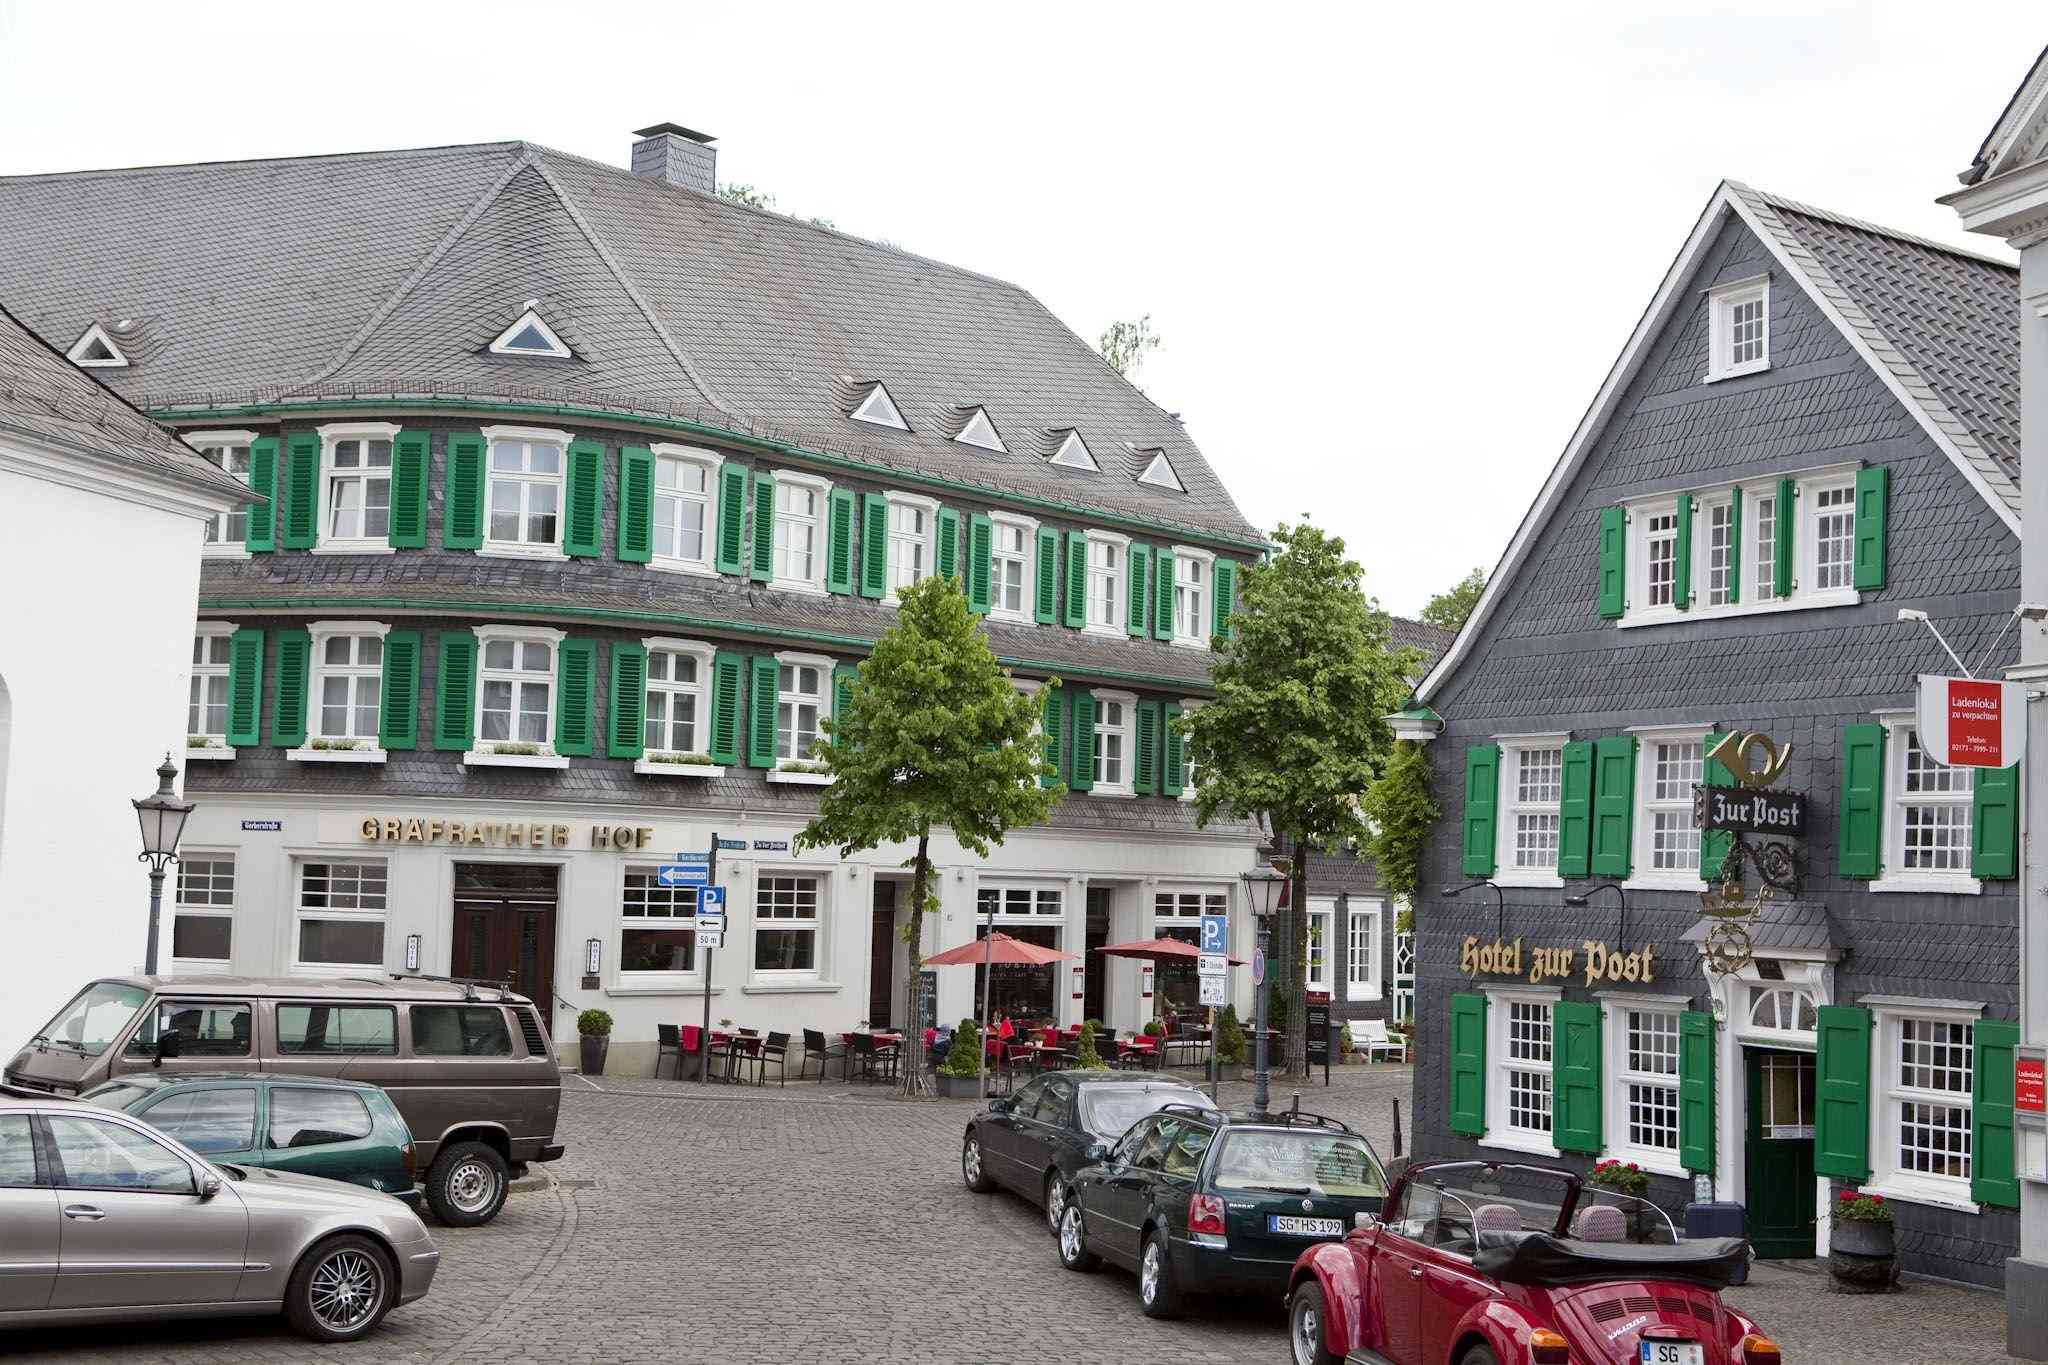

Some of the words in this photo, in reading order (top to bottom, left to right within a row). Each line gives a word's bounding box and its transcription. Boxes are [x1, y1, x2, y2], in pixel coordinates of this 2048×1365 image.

[1952, 696, 1997, 709] Ladenlokal
[1952, 711, 1961, 719] zu
[1962, 711, 1998, 721] verpachten
[1753, 796, 1799, 828] Post
[361, 816, 571, 848] GRÄFRATHER
[591, 823, 656, 849] HOF
[700, 936, 709, 944] 50
[1205, 920, 1219, 949] P
[1459, 935, 1524, 980] Hotel
[1529, 946, 1573, 984] zur
[1583, 939, 1656, 988] Post
[1279, 1218, 1294, 1231] SG
[1301, 1219, 1317, 1232] HS
[1320, 1222, 1341, 1233] 199
[1659, 1345, 1678, 1363] SG
